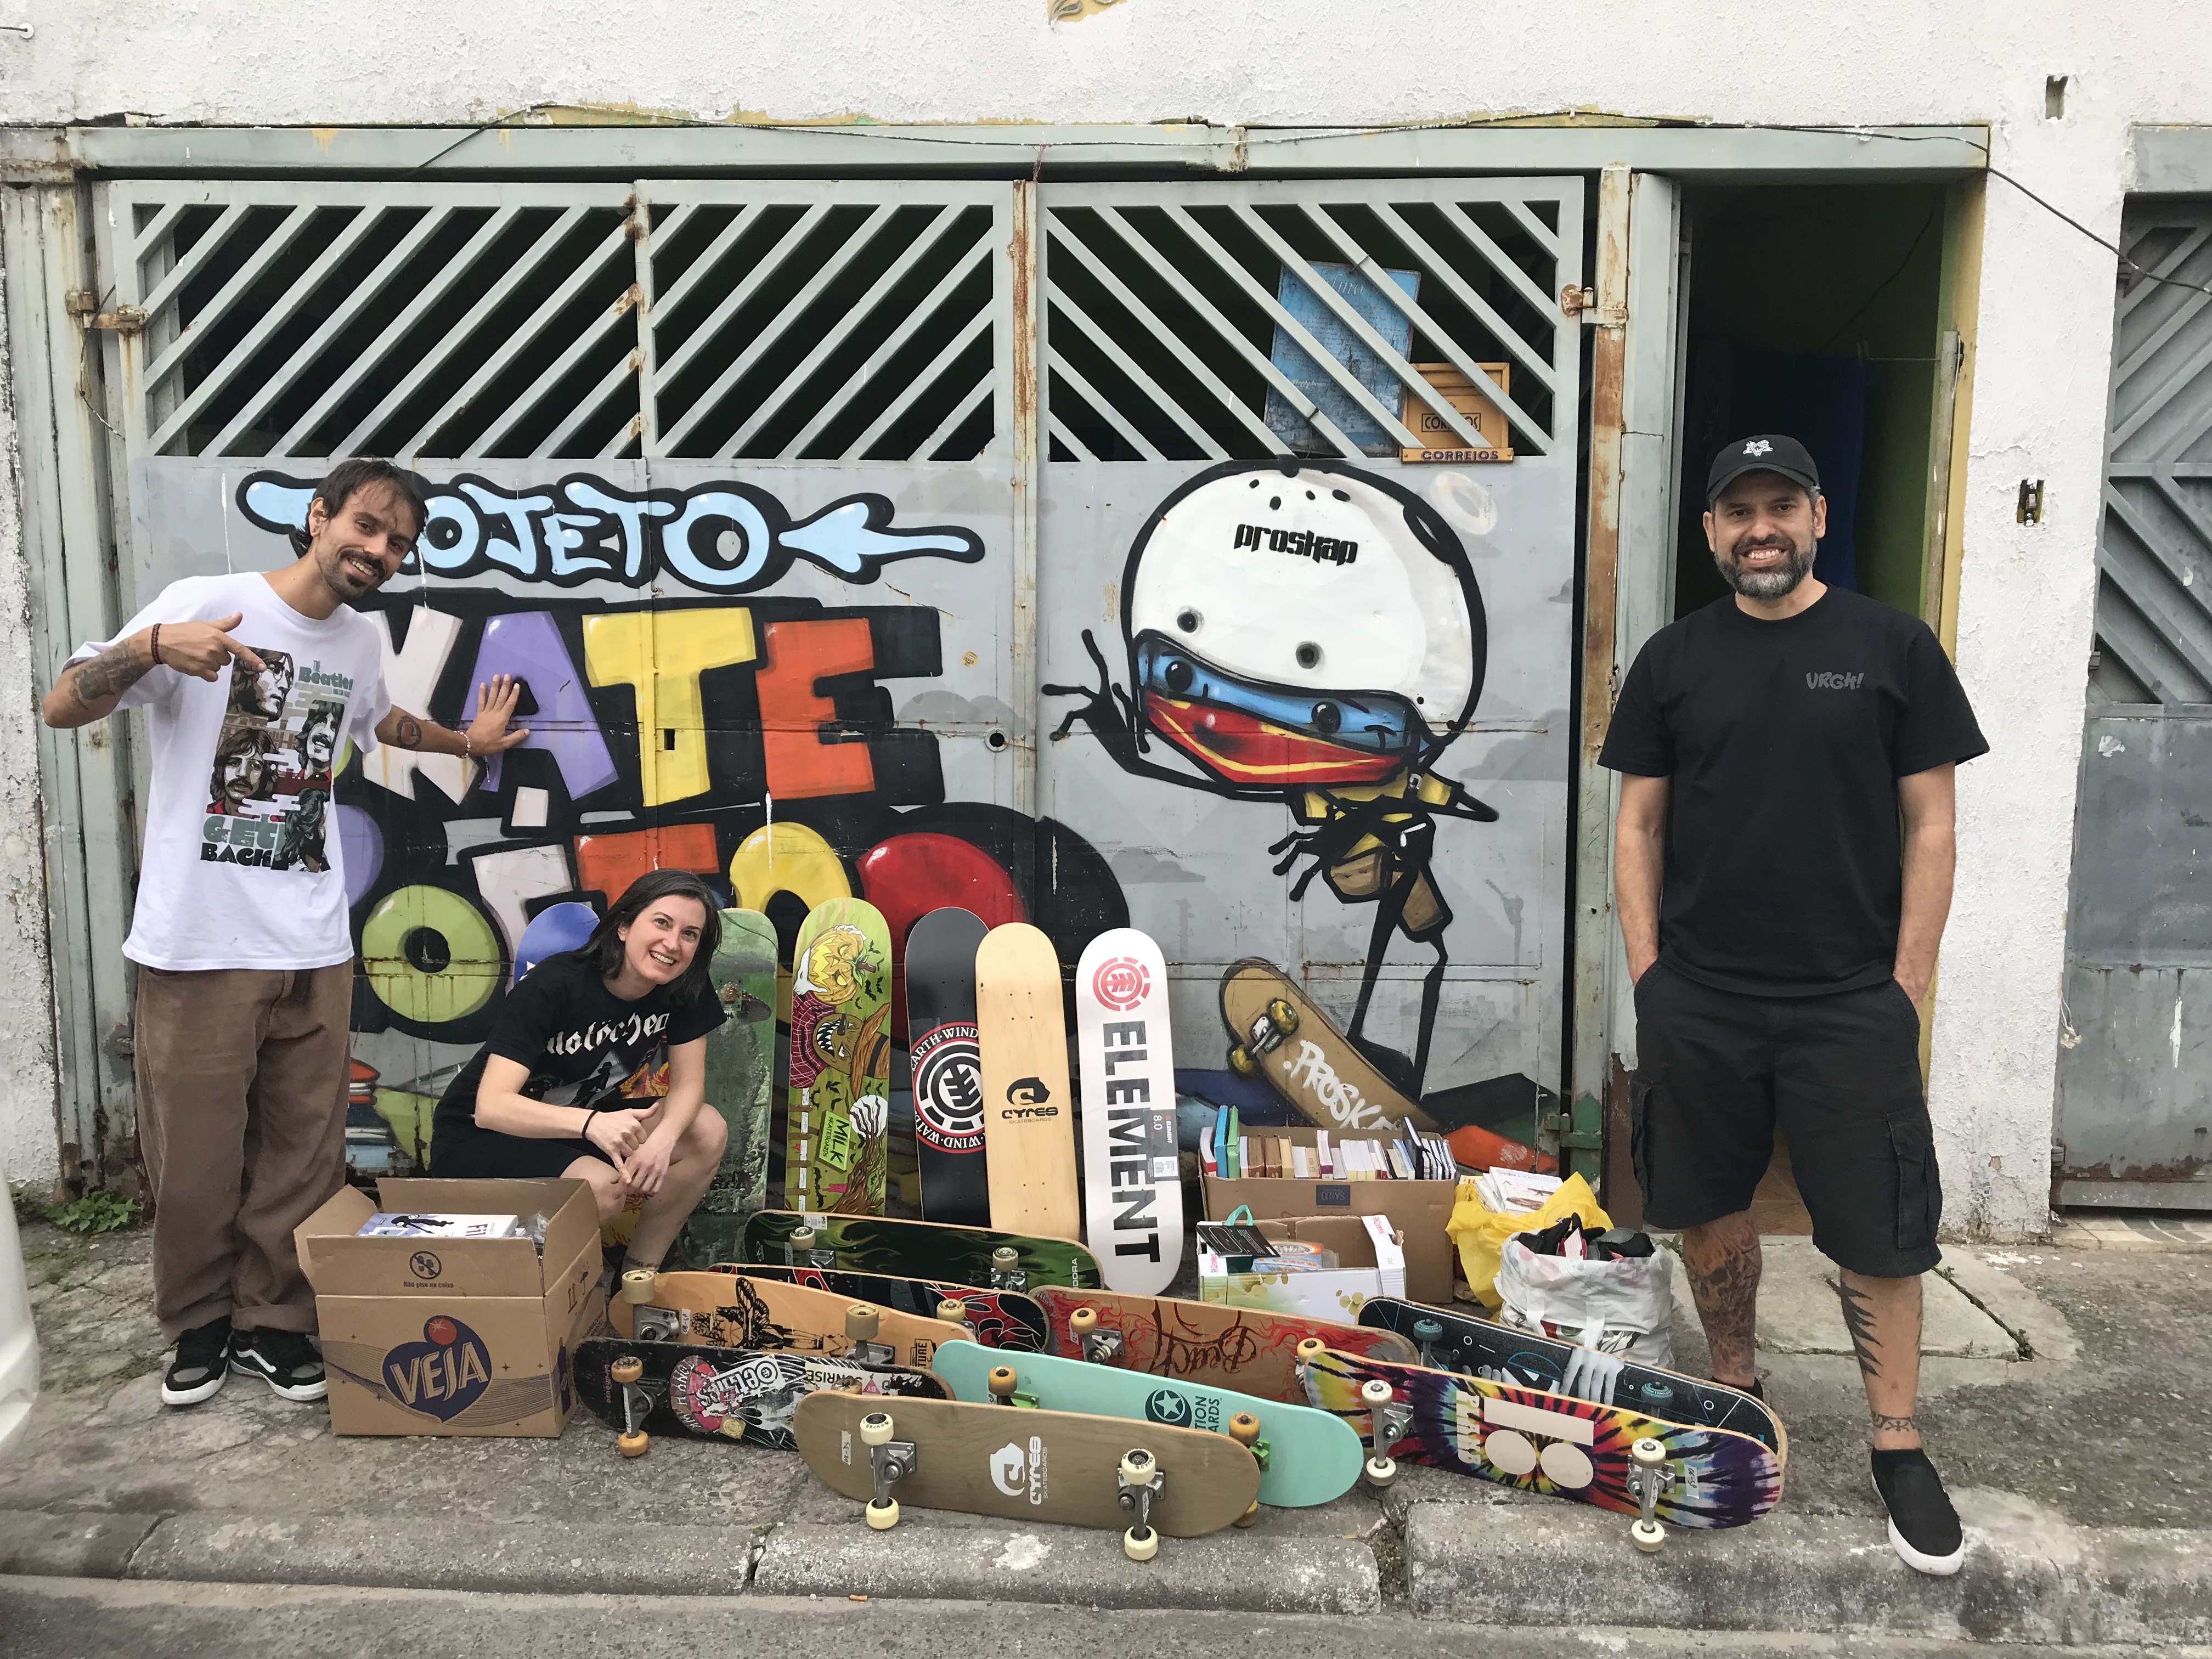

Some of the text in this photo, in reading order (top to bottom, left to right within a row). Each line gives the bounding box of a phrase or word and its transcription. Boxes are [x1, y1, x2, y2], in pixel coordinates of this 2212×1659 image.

[1424, 415, 1479, 430] COROS
[1420, 450, 1499, 461] CORREIOS
[1233, 523, 1358, 567] proskap
[359, 603, 876, 805] KATE
[200, 842, 273, 868] BACK
[822, 1116, 834, 1158] SKATEBOARDS
[830, 1119, 850, 1164] MILK
[1103, 1020, 1160, 1263] ELEMENT
[1153, 1115, 1163, 1130] 8.0
[388, 1341, 489, 1406] VEJA
[1194, 1395, 1207, 1430] TION
[1208, 1397, 1220, 1432] ARDS
